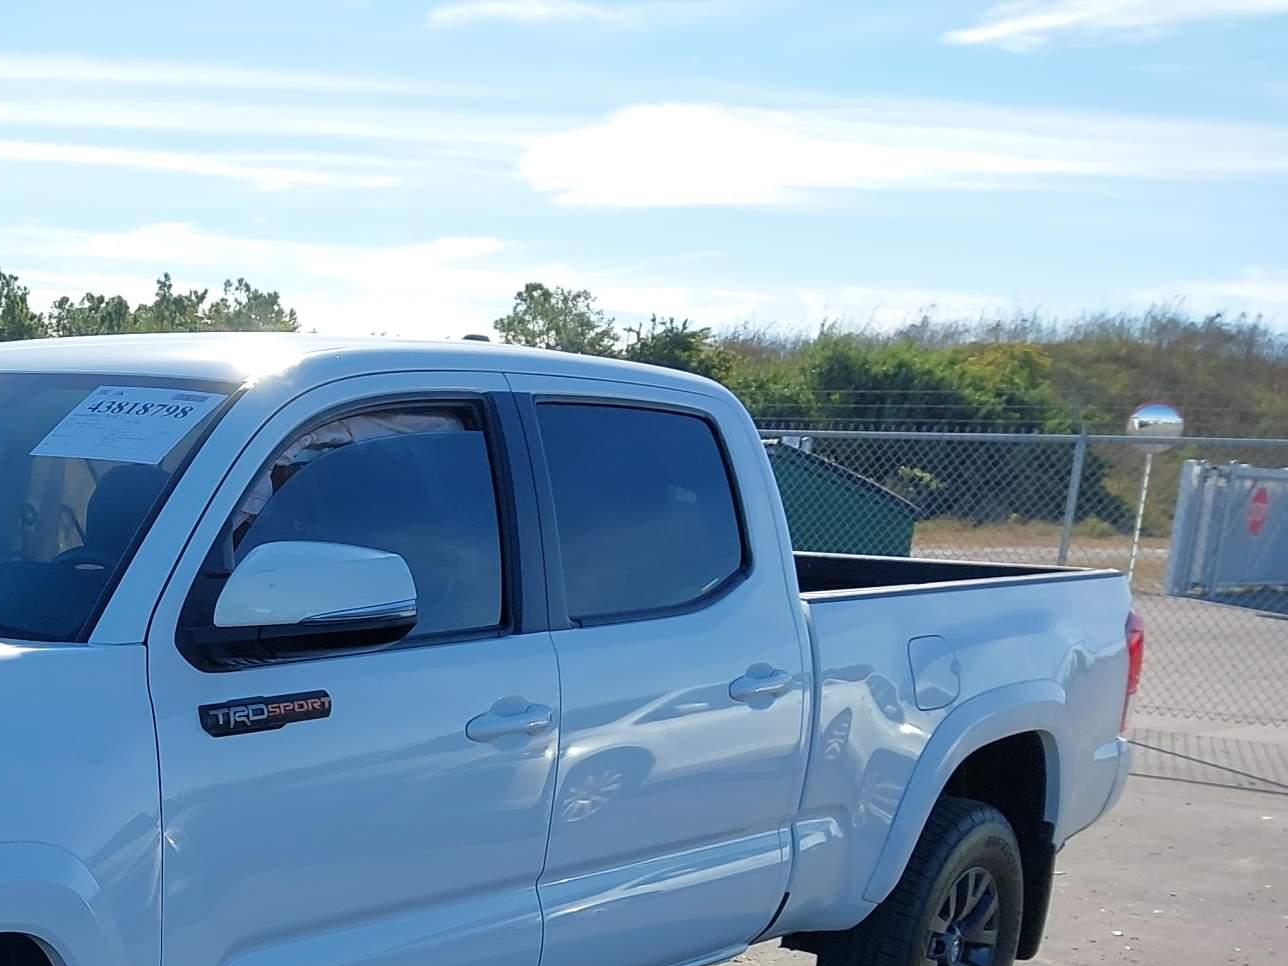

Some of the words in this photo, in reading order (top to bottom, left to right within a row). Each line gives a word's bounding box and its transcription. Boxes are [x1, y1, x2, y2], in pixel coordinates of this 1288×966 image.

[87, 400, 194, 419] 43818798
[208, 703, 268, 728] TRD
[268, 697, 330, 716] SPORT
